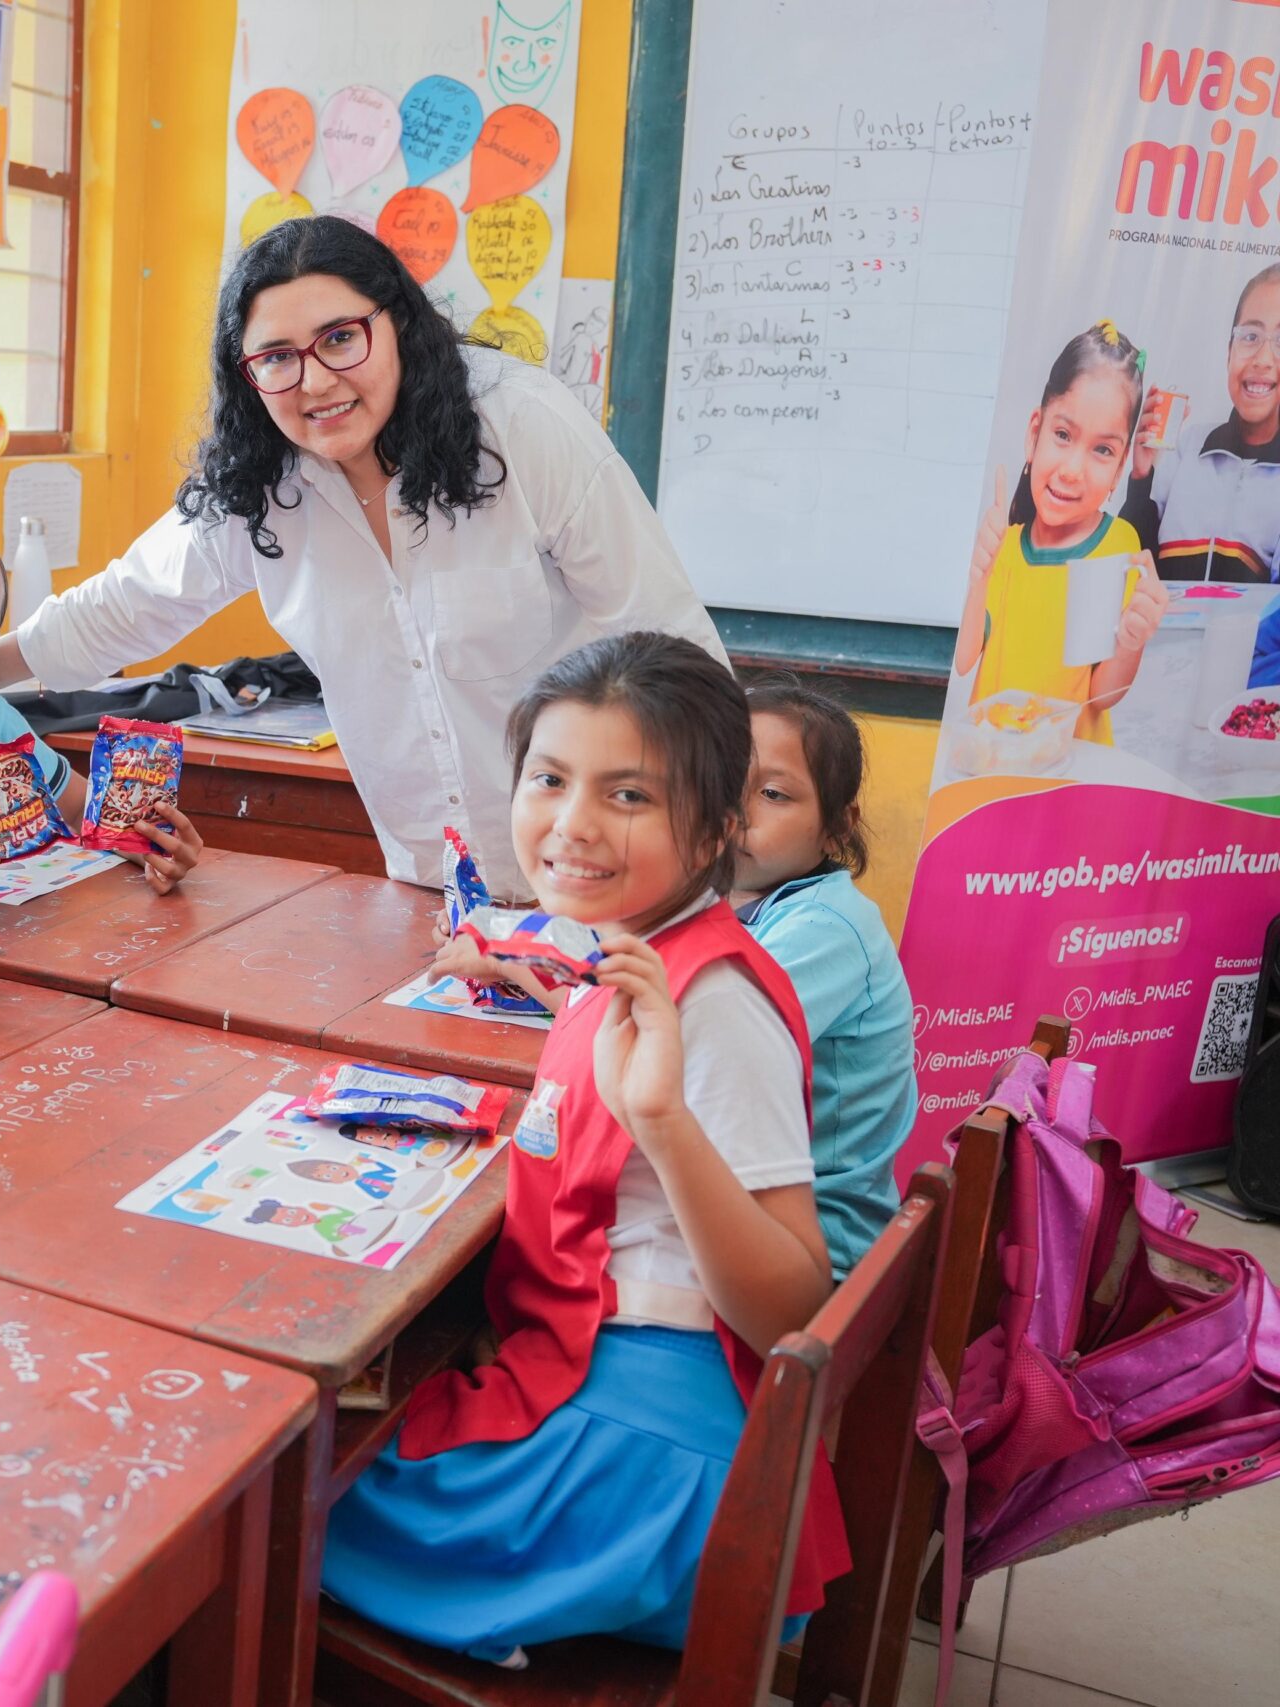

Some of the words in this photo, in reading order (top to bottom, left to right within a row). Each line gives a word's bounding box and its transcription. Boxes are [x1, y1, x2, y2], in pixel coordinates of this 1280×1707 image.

[728, 113, 810, 142] Grupos
[854, 108, 925, 138] Puntos
[948, 135, 1014, 152] extras
[1115, 119, 1280, 229] mik
[812, 206, 828, 223] M
[1108, 228, 1170, 246] PROGRAMA
[1171, 235, 1217, 251] NACIONAL
[1219, 239, 1233, 252] DE
[785, 260, 803, 277] C
[800, 308, 815, 324] L
[693, 433, 712, 455] D
[1057, 916, 1184, 963] ¡Síguenos!
[1215, 955, 1258, 969] Escanea
[928, 1002, 1016, 1030] /Midis.PAE
